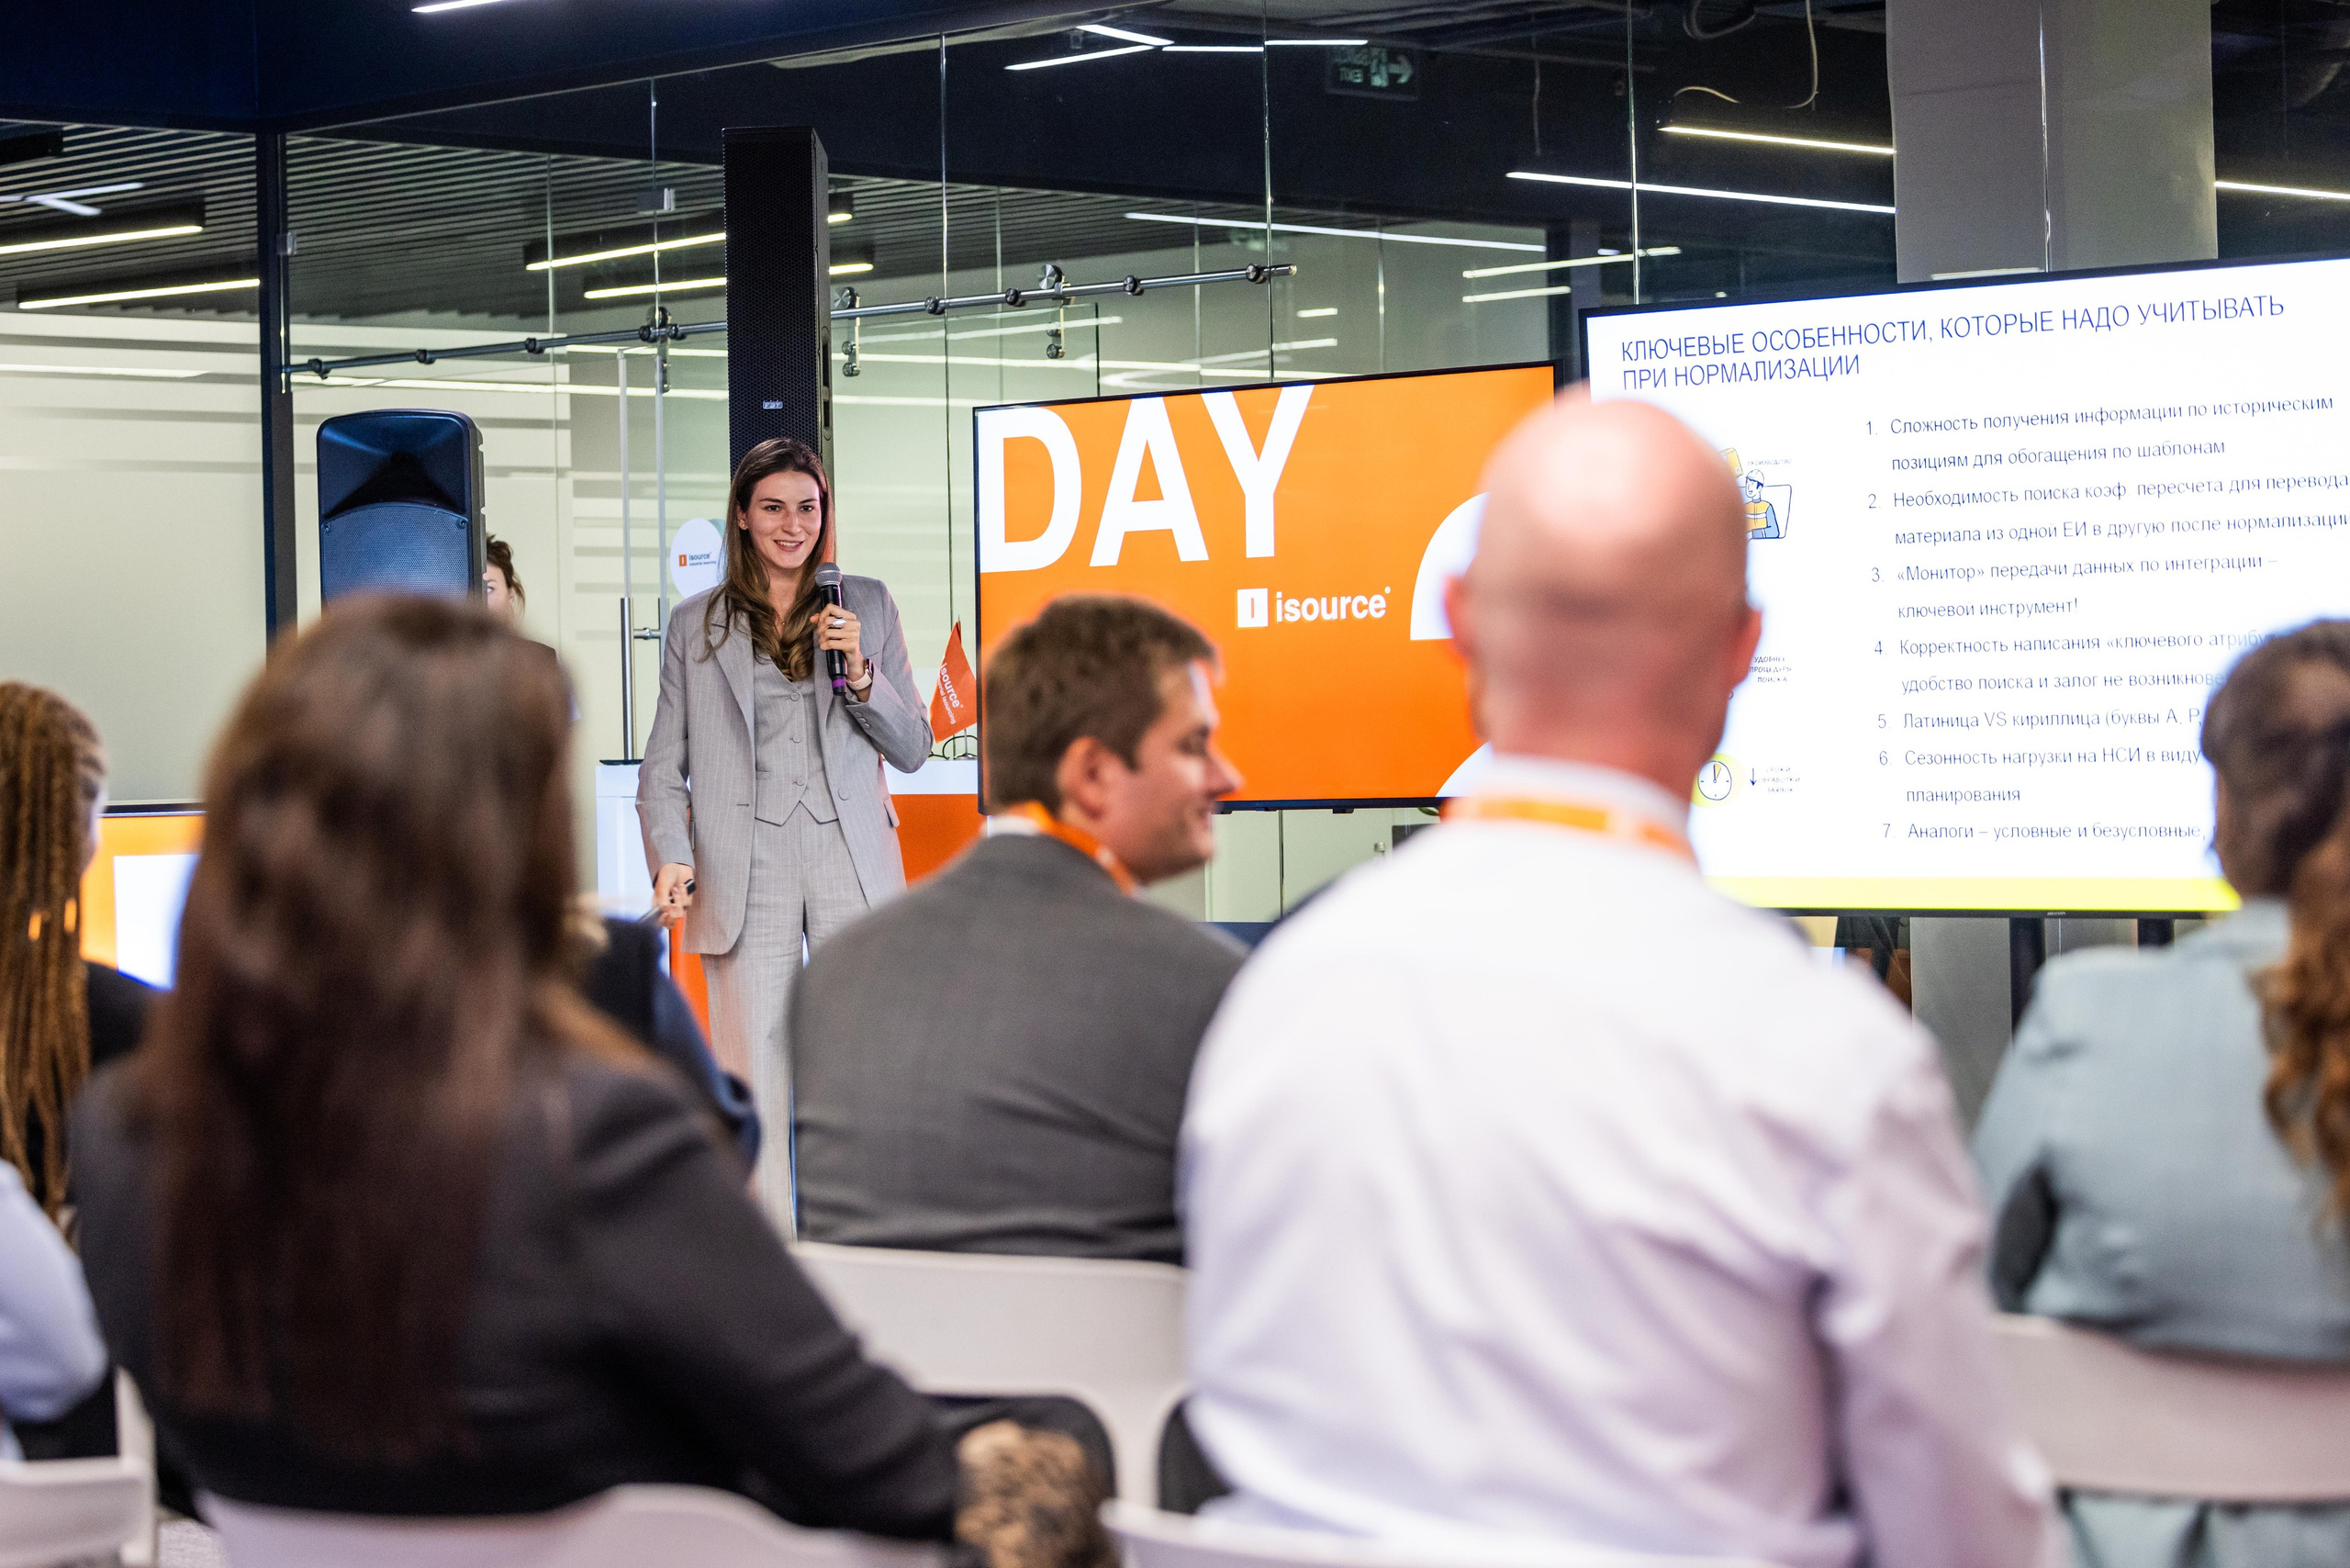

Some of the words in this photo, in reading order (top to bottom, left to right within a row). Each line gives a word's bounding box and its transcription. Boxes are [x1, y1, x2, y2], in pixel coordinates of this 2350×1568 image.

[1621, 332, 1745, 363] КЛЮЧЕВЫЕ
[1751, 319, 1933, 353] ОСОБЕННОСТИ,
[1941, 309, 2054, 340] КОТОРЫЕ
[2062, 304, 2130, 333] НАДО
[2136, 294, 2285, 326] УЧИТЫВАТЬ
[1622, 367, 1667, 391] ПРИ
[1673, 353, 1860, 387] НОРМАЛИЗАЦИИ
[1866, 420, 1878, 435] 1.
[1890, 418, 1978, 434] Сложность
[1983, 412, 2069, 431] получения
[2075, 406, 2182, 427] информации
[2188, 404, 2208, 418] по
[2212, 397, 2333, 418] историческим
[1892, 454, 1968, 473] позициям
[1972, 453, 2003, 469] для
[2008, 447, 2107, 465] обогащения
[2112, 446, 2132, 459] по
[2137, 440, 2225, 458] шаблонам
[978, 385, 1315, 573] DAY
[1867, 493, 1881, 509] 2.
[1893, 489, 2019, 508] Необходимость
[2024, 487, 2080, 501] поиска
[2137, 480, 2223, 499] пересчета
[2228, 478, 2261, 495] для
[2266, 475, 2349, 493] перевода
[1895, 529, 1982, 547] материала
[1986, 528, 2004, 541] из
[2009, 523, 2057, 542] одной
[2063, 521, 2087, 538] ЕИ
[2092, 524, 2102, 536] в
[2107, 521, 2165, 539] другую
[2171, 519, 2221, 532] после
[1871, 566, 1885, 583] 3.
[1897, 565, 1985, 583] «Монитор»
[1990, 564, 2067, 581] передачи
[2072, 561, 2134, 577] данных
[2140, 560, 2160, 572] по
[2165, 556, 2262, 574] интеграции
[1898, 601, 1975, 618] ключевой
[1979, 597, 2077, 619] инструмент!
[1899, 639, 2009, 658] Корректность
[2013, 637, 2100, 652] написания
[2107, 634, 2203, 649] «ключевого
[1901, 675, 1973, 696] удобство
[1978, 677, 2033, 690] поиска
[2039, 677, 2048, 689] и
[2053, 675, 2098, 689] залог
[2103, 675, 2123, 688] не
[1903, 712, 1979, 732] Латиница
[2012, 713, 2100, 731] кириллица
[2105, 709, 2160, 728] (буквы
[1905, 749, 1998, 766] Сезонность
[2002, 752, 2072, 767] нагрузки
[2077, 751, 2097, 763] на
[2102, 746, 2141, 763] НСИ
[2146, 750, 2156, 763] в
[1906, 790, 2020, 806] планирования
[1908, 823, 1974, 839] Аналоги
[1993, 826, 2072, 842] условные
[2077, 826, 2087, 838] и
